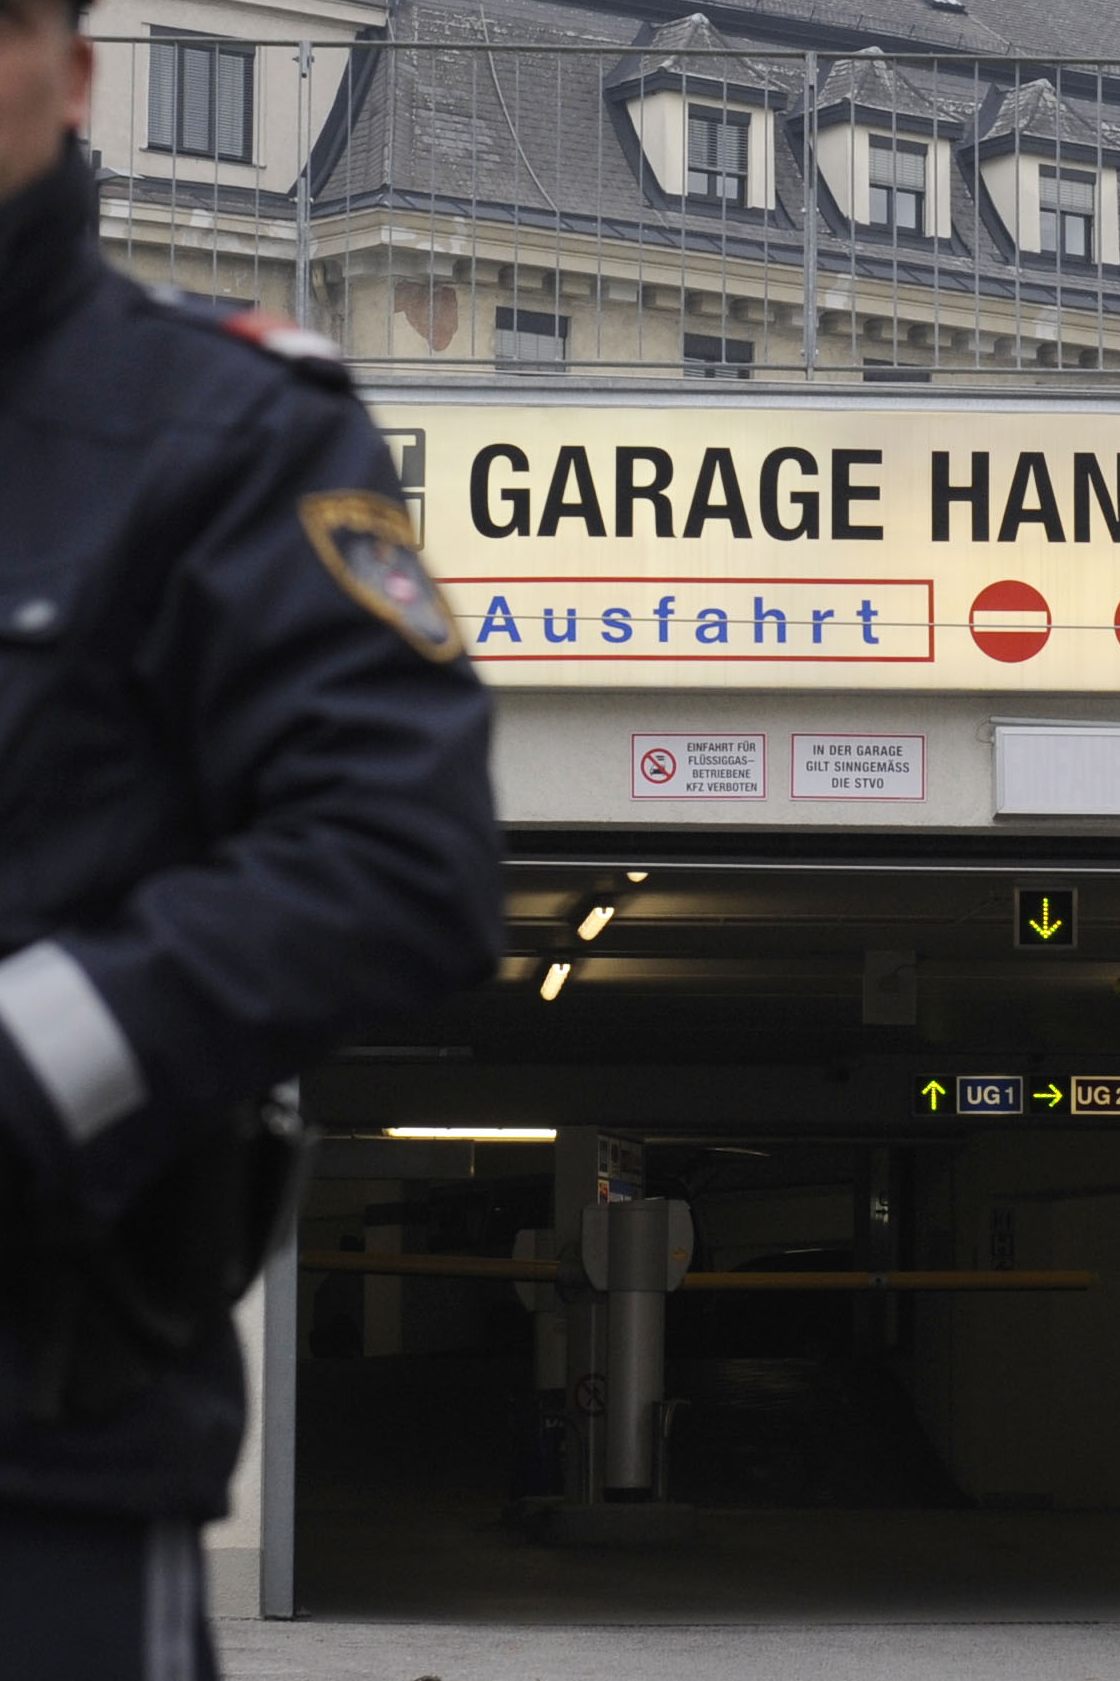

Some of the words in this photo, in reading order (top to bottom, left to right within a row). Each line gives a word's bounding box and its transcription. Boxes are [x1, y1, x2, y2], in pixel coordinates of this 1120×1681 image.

[470, 444, 883, 541] GARAGE
[478, 596, 879, 644] Ausfahrt
[686, 742, 734, 753] EINFAHRT
[737, 740, 756, 753] FÜR
[812, 744, 825, 756] IN
[829, 744, 852, 756] DER
[856, 745, 903, 757] GARAGE
[688, 753, 755, 766] FLÜSSIGGAS-
[805, 760, 830, 772] GILT
[834, 759, 910, 773] SINNGEMÄSS
[692, 768, 751, 779] BETRIEBENE
[686, 782, 705, 792] KFZ
[707, 782, 758, 792] VERBOTEN
[831, 777, 850, 789] DIE
[854, 777, 885, 789] STVO
[1078, 1086, 1110, 1104] UG
